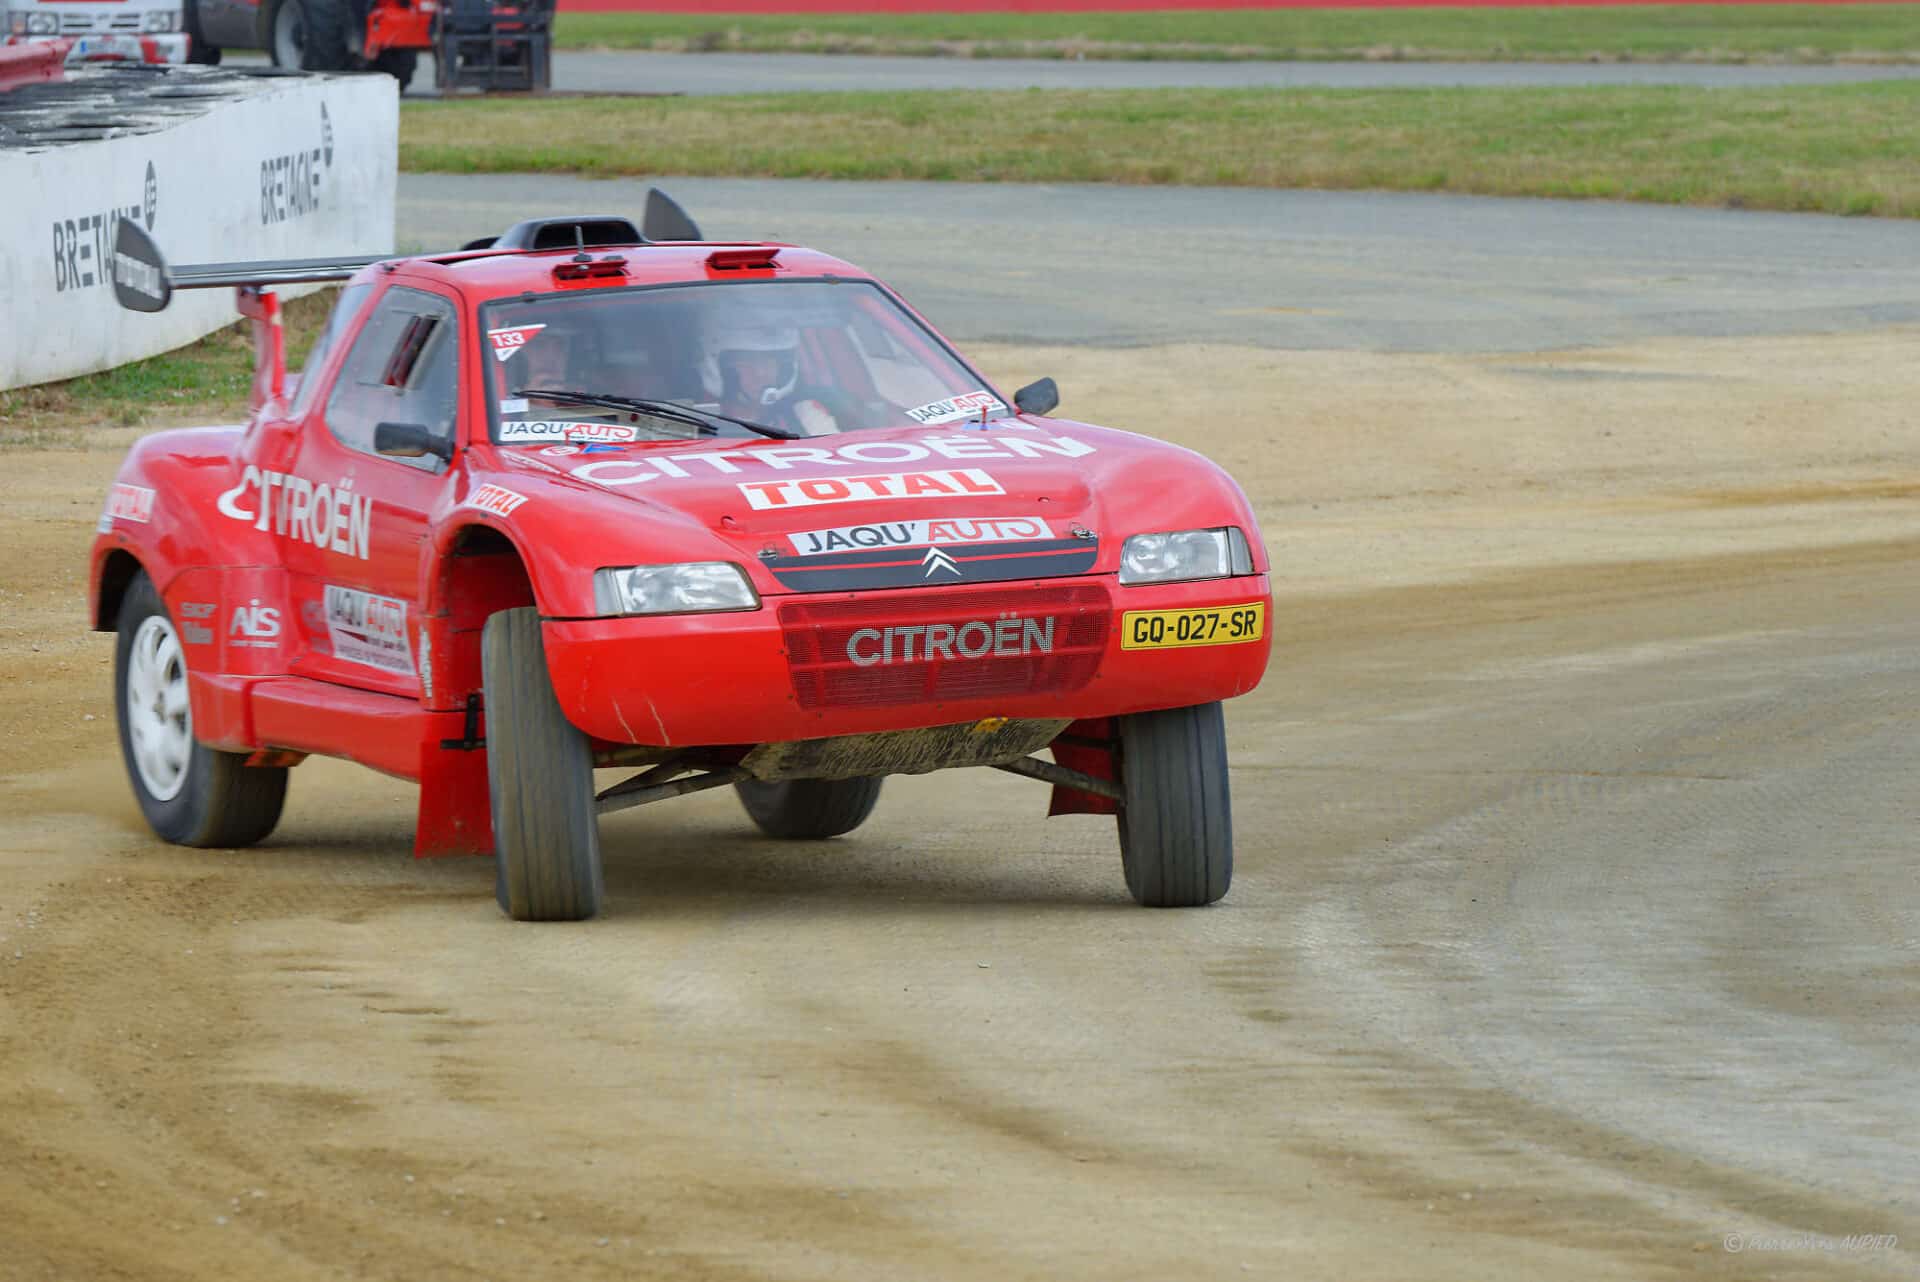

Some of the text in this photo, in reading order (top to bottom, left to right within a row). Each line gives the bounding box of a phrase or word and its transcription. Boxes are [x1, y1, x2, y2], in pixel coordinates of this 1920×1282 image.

[261, 148, 320, 225] BRETAGNE
[53, 205, 141, 291] BRETA
[491, 332, 525, 347] 133
[570, 435, 1096, 486] CITROËN
[476, 486, 518, 513] TOTAL
[745, 473, 1000, 505] TOTAL
[217, 465, 371, 560] CITROËN
[808, 517, 1042, 553] JAQU'AUTO
[847, 611, 1055, 666] CITROËN
[1134, 609, 1257, 643] GQ-027-SR
